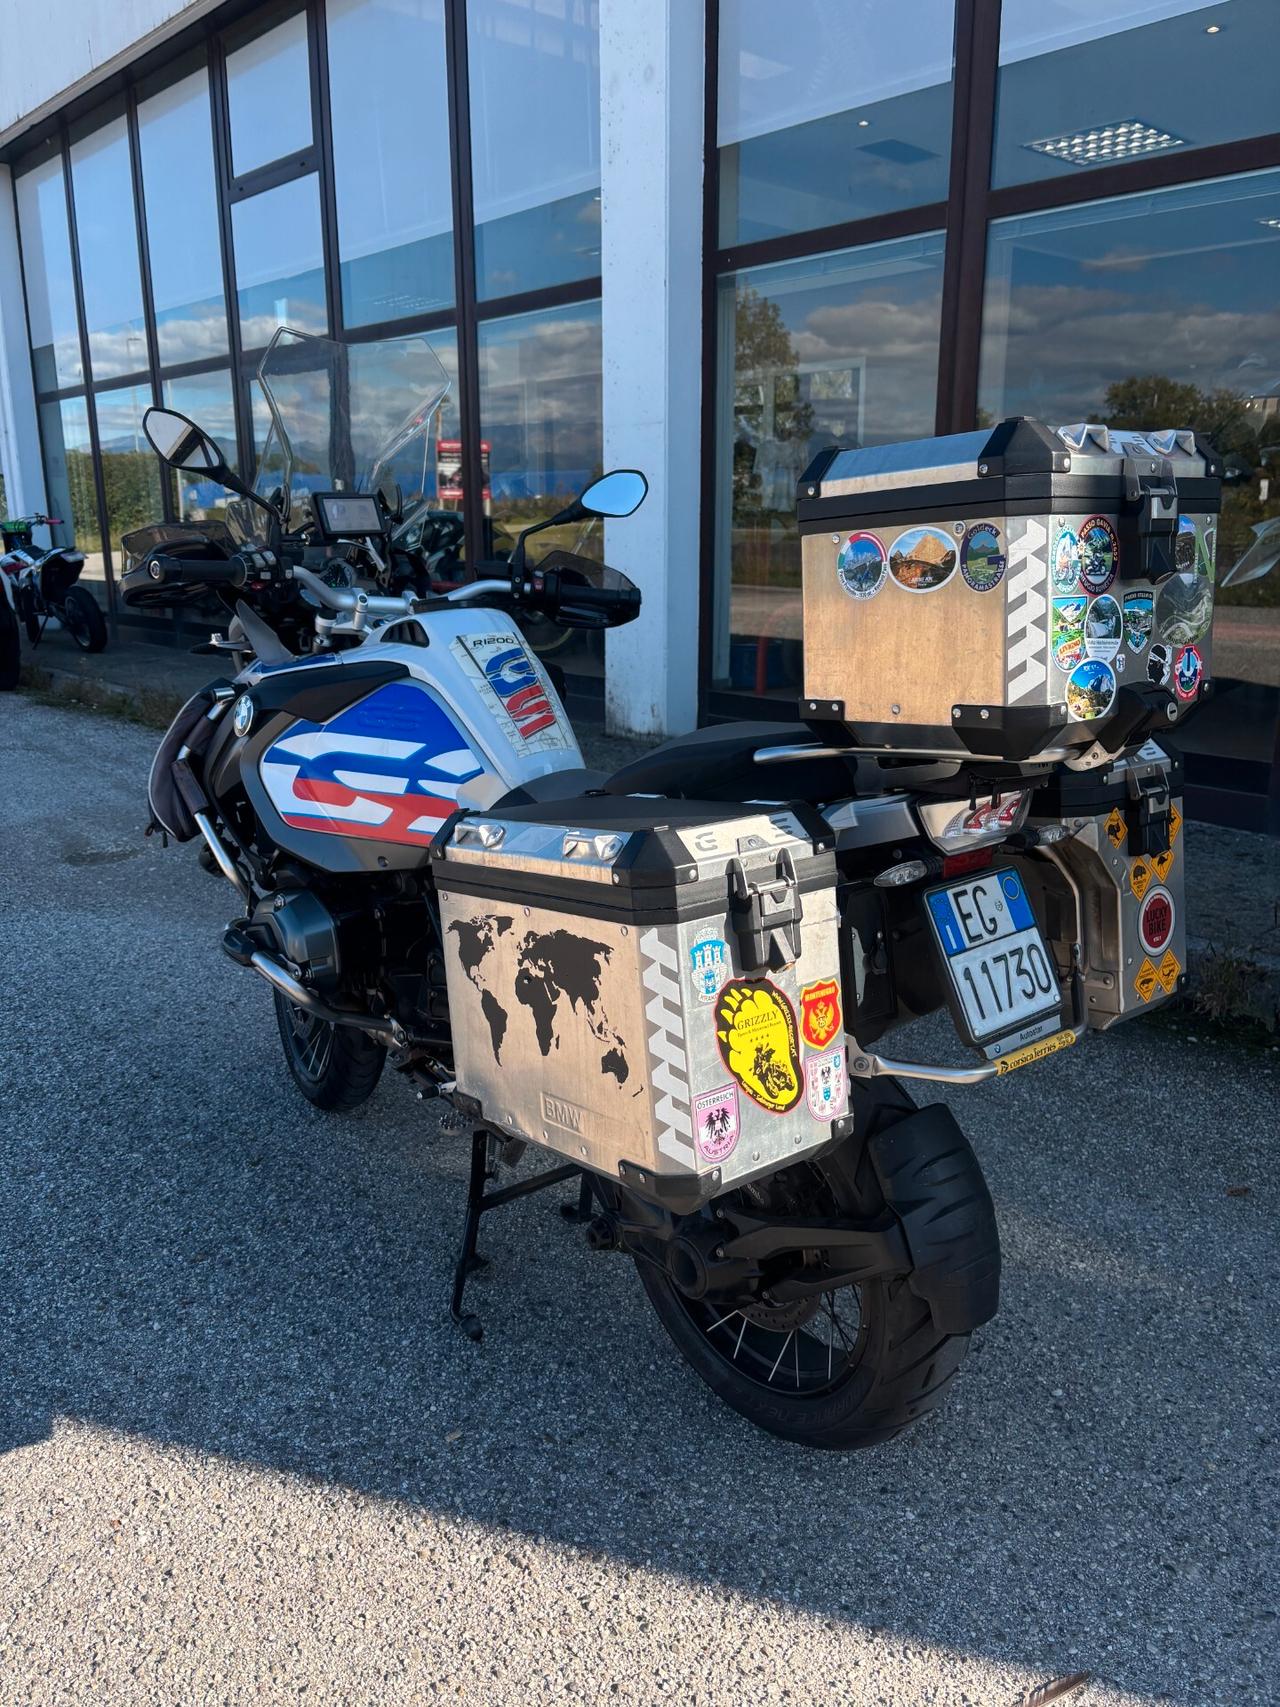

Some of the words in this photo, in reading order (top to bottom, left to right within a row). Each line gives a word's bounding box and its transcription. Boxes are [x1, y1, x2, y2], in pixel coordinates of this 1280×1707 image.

[966, 524, 998, 539] Goldeck
[1081, 519, 1096, 538] PASSO
[962, 560, 1005, 592] PANORAMASTRASSE
[473, 637, 514, 647] R1200
[1146, 906, 1168, 922] LUCKY
[1149, 919, 1166, 935] BIKE
[963, 943, 1051, 1020] 11730
[737, 1010, 779, 1031] GRIZZLY
[1020, 1026, 1043, 1041] Autostar
[1010, 1052, 1034, 1068] corsica
[1033, 1041, 1057, 1058] ferries
[697, 1091, 734, 1110] ÖSTERREICH
[544, 1097, 583, 1129] BMW
[703, 1134, 735, 1155] AUSTRIA
